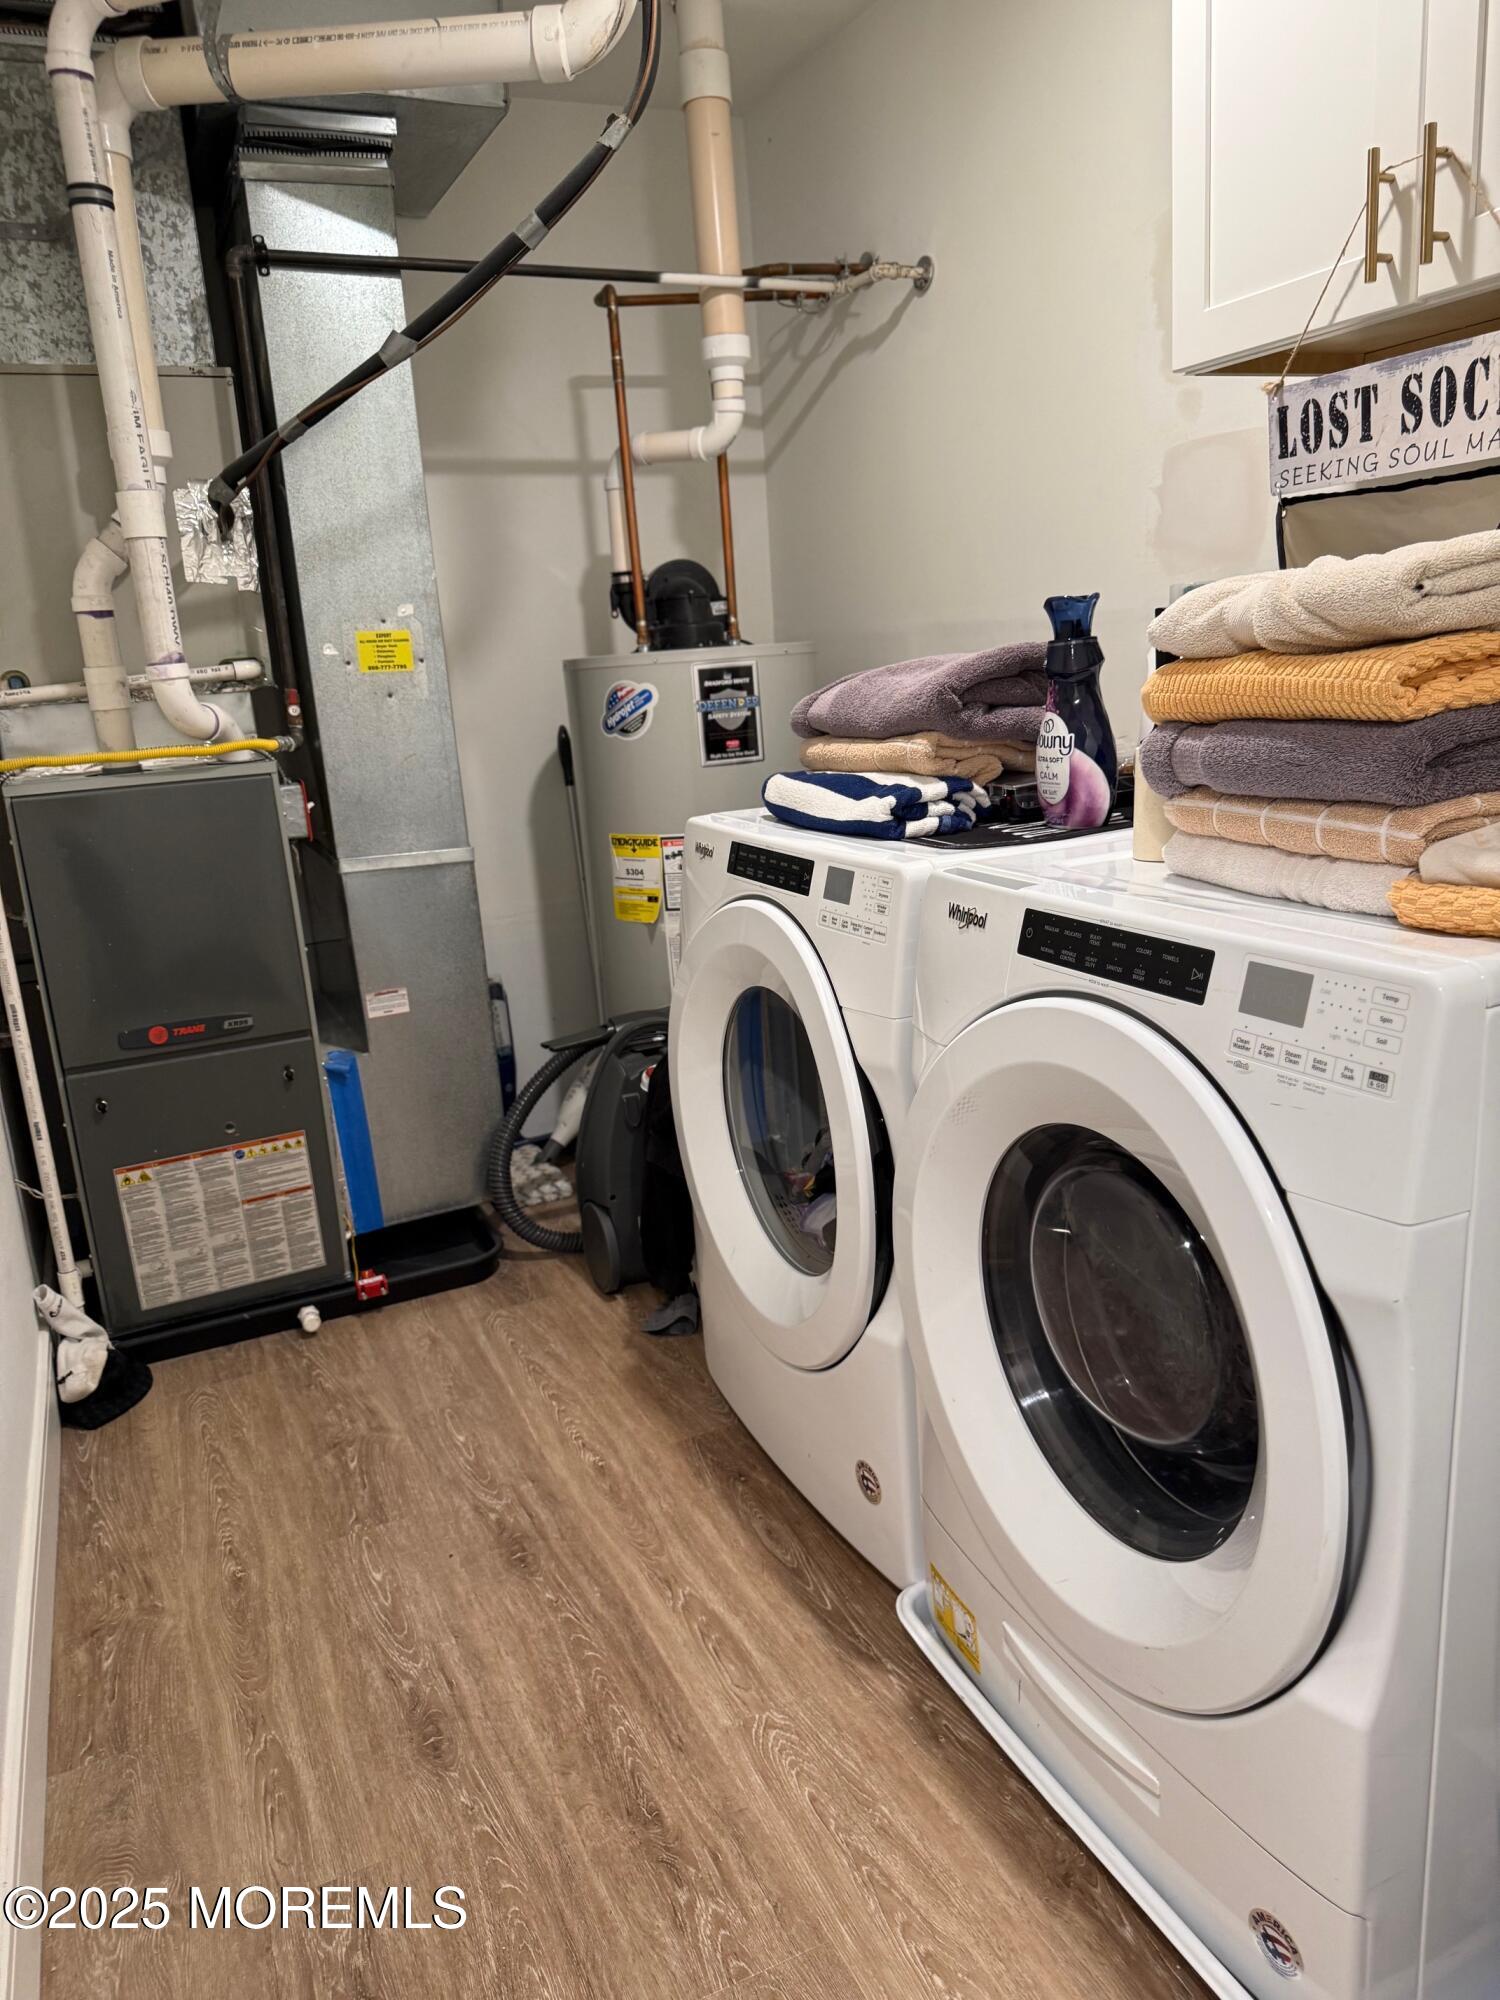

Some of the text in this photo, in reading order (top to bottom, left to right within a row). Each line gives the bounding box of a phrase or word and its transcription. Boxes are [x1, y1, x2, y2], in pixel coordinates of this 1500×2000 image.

[1277, 354, 1500, 460] LOST SOC
[1275, 453, 1378, 489] SEEKING
[1388, 438, 1454, 469] SOUL
[698, 696, 759, 712] DEFENDER
[1040, 771, 1058, 780] CALM
[626, 868, 644, 876] $304
[948, 902, 988, 930] Whirlpool
[1136, 946, 1152, 956] COLORS
[1162, 953, 1180, 963] TOWELS
[1134, 968, 1146, 976] COLD
[1132, 974, 1144, 982] WASH
[1158, 978, 1172, 986] QUICK
[1382, 993, 1400, 1003] Temp
[1380, 1016, 1394, 1024] Spin
[172, 1024, 206, 1036] TRANE
[1236, 1036, 1250, 1045] Clean
[1232, 1042, 1251, 1052] Washer
[1260, 1043, 1274, 1052] Drain
[1264, 1050, 1274, 1058] Spin
[1284, 1050, 1302, 1059] Steam
[1284, 1056, 1300, 1066] Clean
[1312, 1058, 1328, 1066] Extra
[1312, 1064, 1327, 1073] Rinse
